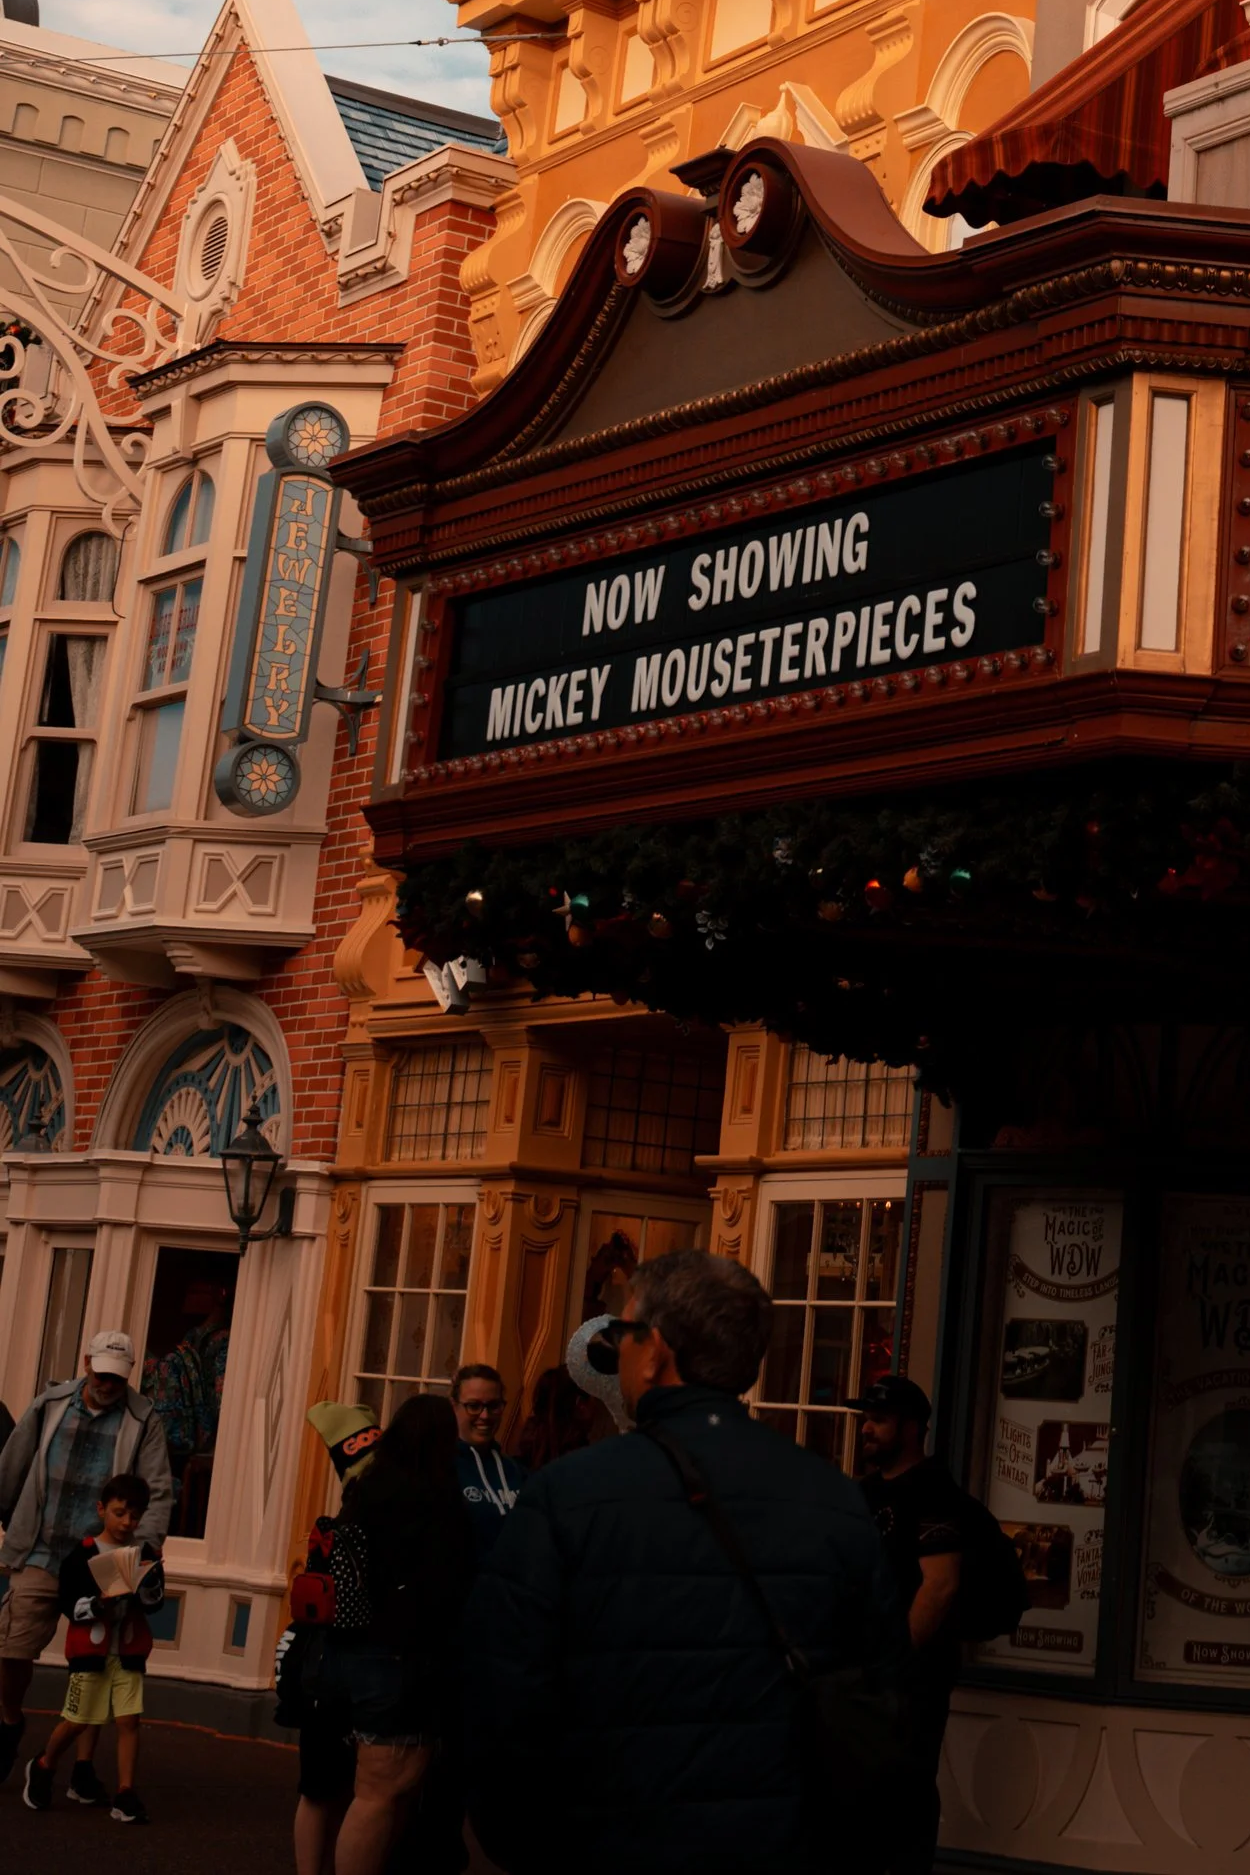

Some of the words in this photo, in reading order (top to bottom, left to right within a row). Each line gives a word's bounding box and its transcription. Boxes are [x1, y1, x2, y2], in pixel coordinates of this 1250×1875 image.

[582, 565, 665, 636] NOW
[688, 512, 870, 611] SHOWING
[265, 488, 313, 727] JEWELRY
[486, 664, 611, 741] MICKEY
[631, 581, 977, 713] MOUSETERPIECES
[1068, 1206, 1086, 1218] THE
[1043, 1213, 1090, 1244] MAGIC
[1050, 1242, 1103, 1276] WDW
[1000, 1419, 1031, 1449] FLIGHTS
[996, 1456, 1029, 1486] FANTASY
[1181, 1589, 1200, 1604] OF
[1204, 1597, 1228, 1613] THE
[1192, 1641, 1218, 1661] NOW
